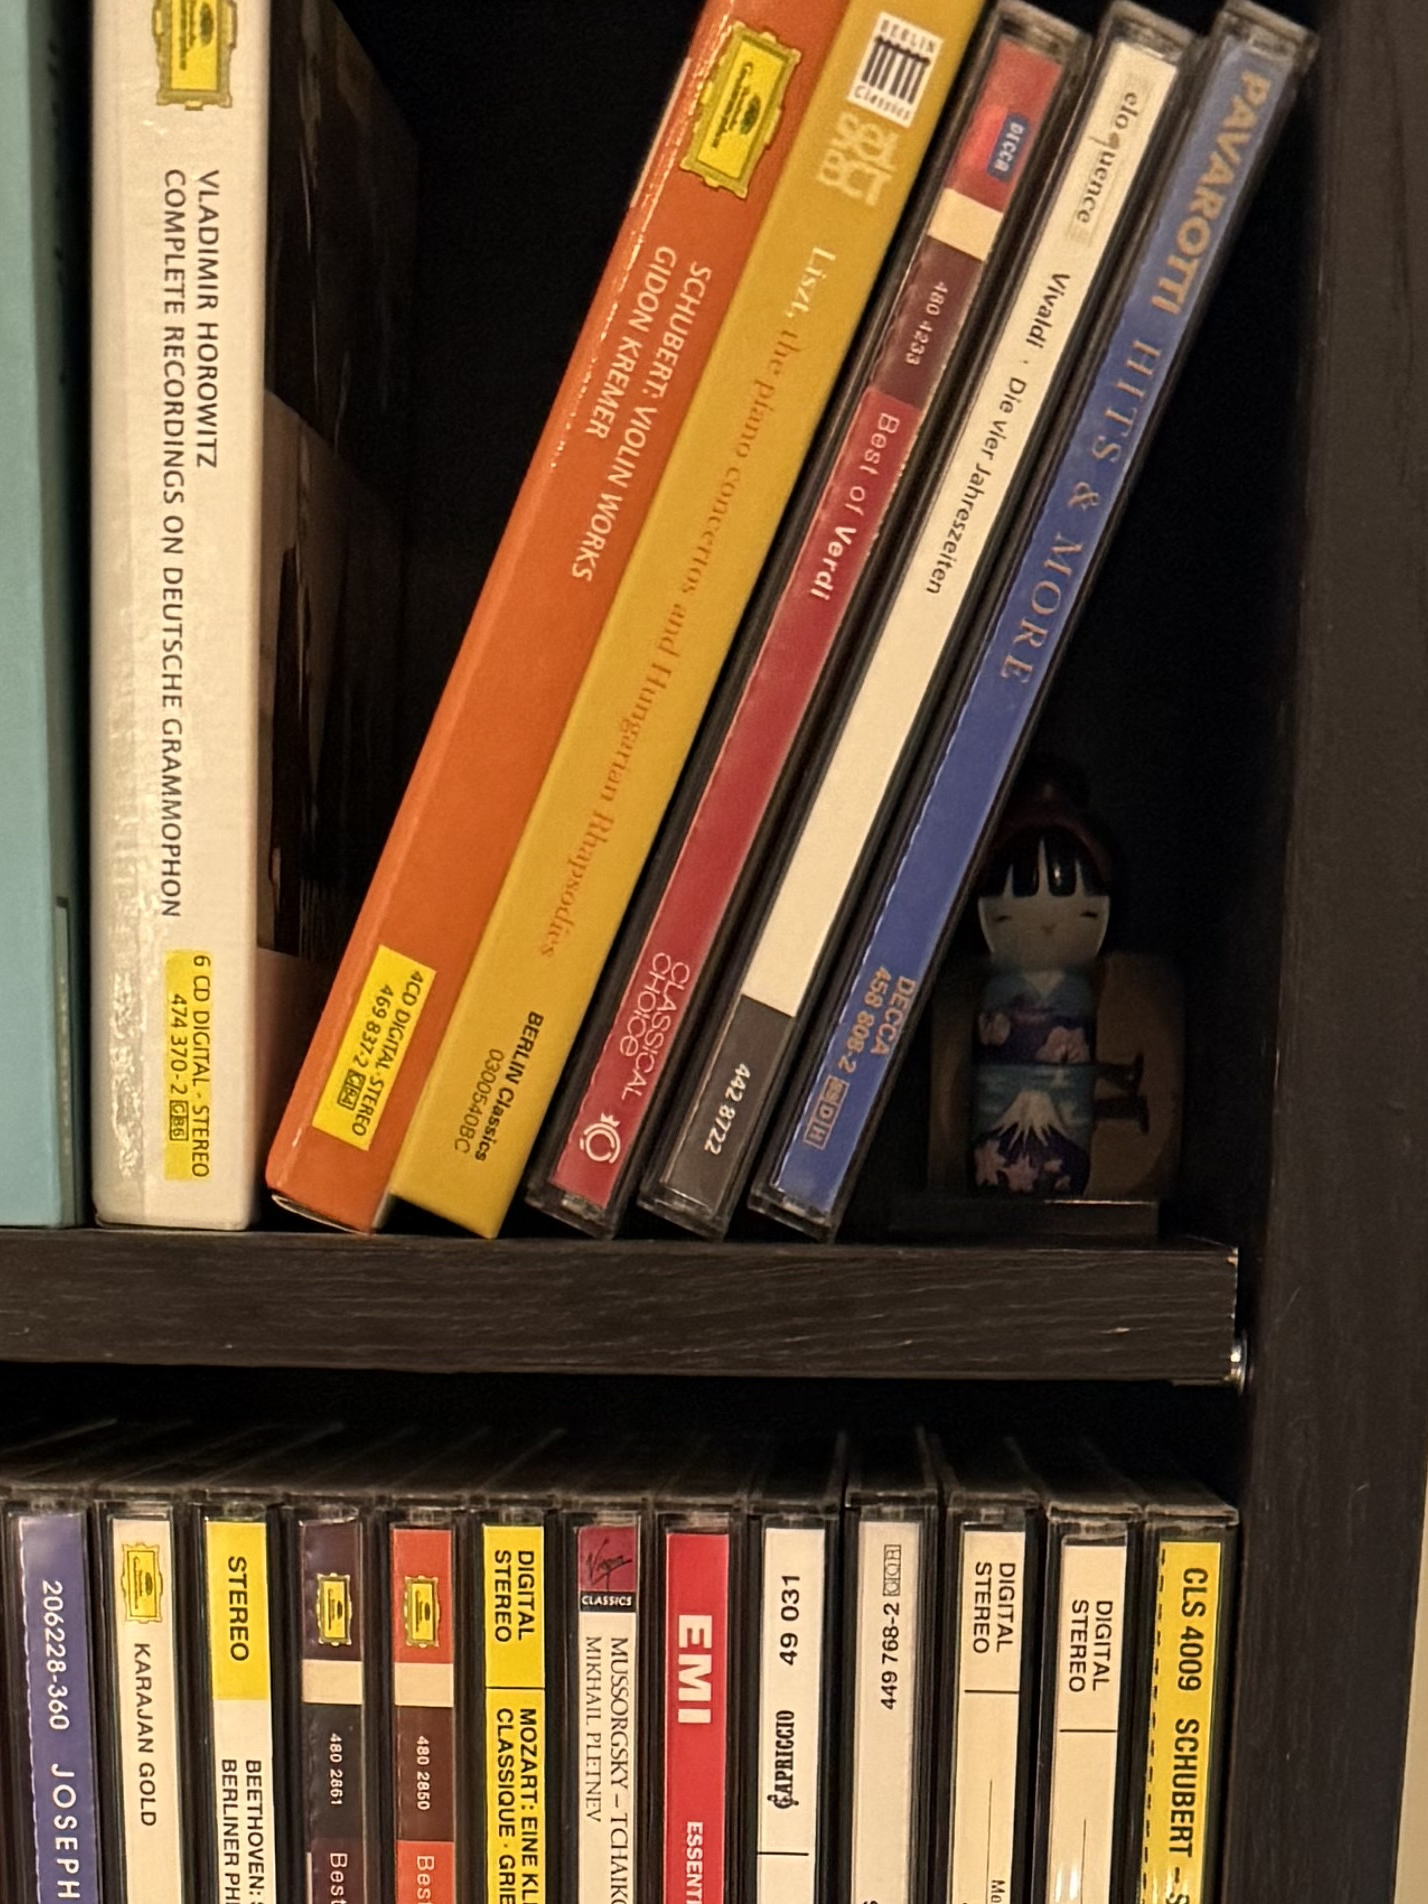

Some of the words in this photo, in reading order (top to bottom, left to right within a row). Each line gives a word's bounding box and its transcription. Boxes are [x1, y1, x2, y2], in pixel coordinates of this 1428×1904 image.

[1152, 70, 1270, 314] PAVAROTTI
[163, 170, 186, 314] COMPLETE
[197, 170, 220, 309] VLADIMIR
[785, 247, 836, 318] Liszt,
[628, 247, 676, 332] GIDON
[643, 261, 712, 398] SCHUBERT:
[1026, 272, 1070, 348] Vivaldi
[196, 325, 220, 469] HOROWITZ
[585, 336, 642, 438] KREMER
[769, 330, 800, 375] the
[999, 376, 1026, 414] Die
[163, 326, 184, 504] RECORDINGS
[608, 406, 658, 488] VIOLIN
[735, 379, 775, 459] piano
[860, 412, 899, 475] Best
[981, 420, 1007, 460] vier
[1091, 340, 1160, 463] HITS
[163, 517, 183, 554] ON
[572, 493, 623, 581] WORKS
[682, 467, 740, 593] concertos
[810, 525, 856, 600] Verdi
[926, 463, 992, 594] Jahreszeiten
[161, 567, 184, 707] DEUTSCHE
[659, 602, 686, 659] and
[1000, 532, 1082, 683] MORE
[597, 668, 672, 803] Hungarian
[161, 719, 183, 918] GRAMMOPHON
[542, 808, 615, 958] Rhapsodies
[194, 976, 210, 1002] CD
[622, 961, 690, 1100] CLASSICAL
[192, 1009, 210, 1086] DIGITAL
[505, 1011, 544, 1085] BERLIN
[192, 1105, 210, 1178] STEREO
[475, 1087, 514, 1161] Classics
[228, 1556, 248, 1662] STEREO
[494, 1550, 510, 1642] STEREO
[517, 1550, 534, 1641] DIGITAL
[581, 1595, 631, 1606] CLASSICS
[781, 1576, 801, 1621] 031
[973, 1562, 991, 1654] STEREO
[997, 1563, 1015, 1653] DIGITAL
[1181, 1568, 1208, 1618] CLS
[41, 1581, 69, 1730] 206228-360
[585, 1637, 602, 1727] MIKHAIL
[678, 1615, 713, 1724] EMI
[780, 1634, 799, 1665] 49
[881, 1672, 897, 1710] 449
[1069, 1600, 1089, 1693] STEREO
[1092, 1601, 1113, 1691] DIGITAL
[1178, 1625, 1206, 1691] 4009
[134, 1643, 153, 1753] KARAJAN
[610, 1637, 628, 1791] MUSSORGSKY
[138, 1762, 156, 1827] GOLD
[497, 1709, 516, 1837] CLASSIQUE
[519, 1709, 538, 1811] MOZART:
[586, 1732, 602, 1822] PLETNEV
[1170, 1719, 1199, 1858] SCHUBERT
[52, 1765, 81, 1899] JOSEPH
[221, 1759, 240, 1866] BERLINER
[245, 1759, 266, 1896] BEETHOVEN:
